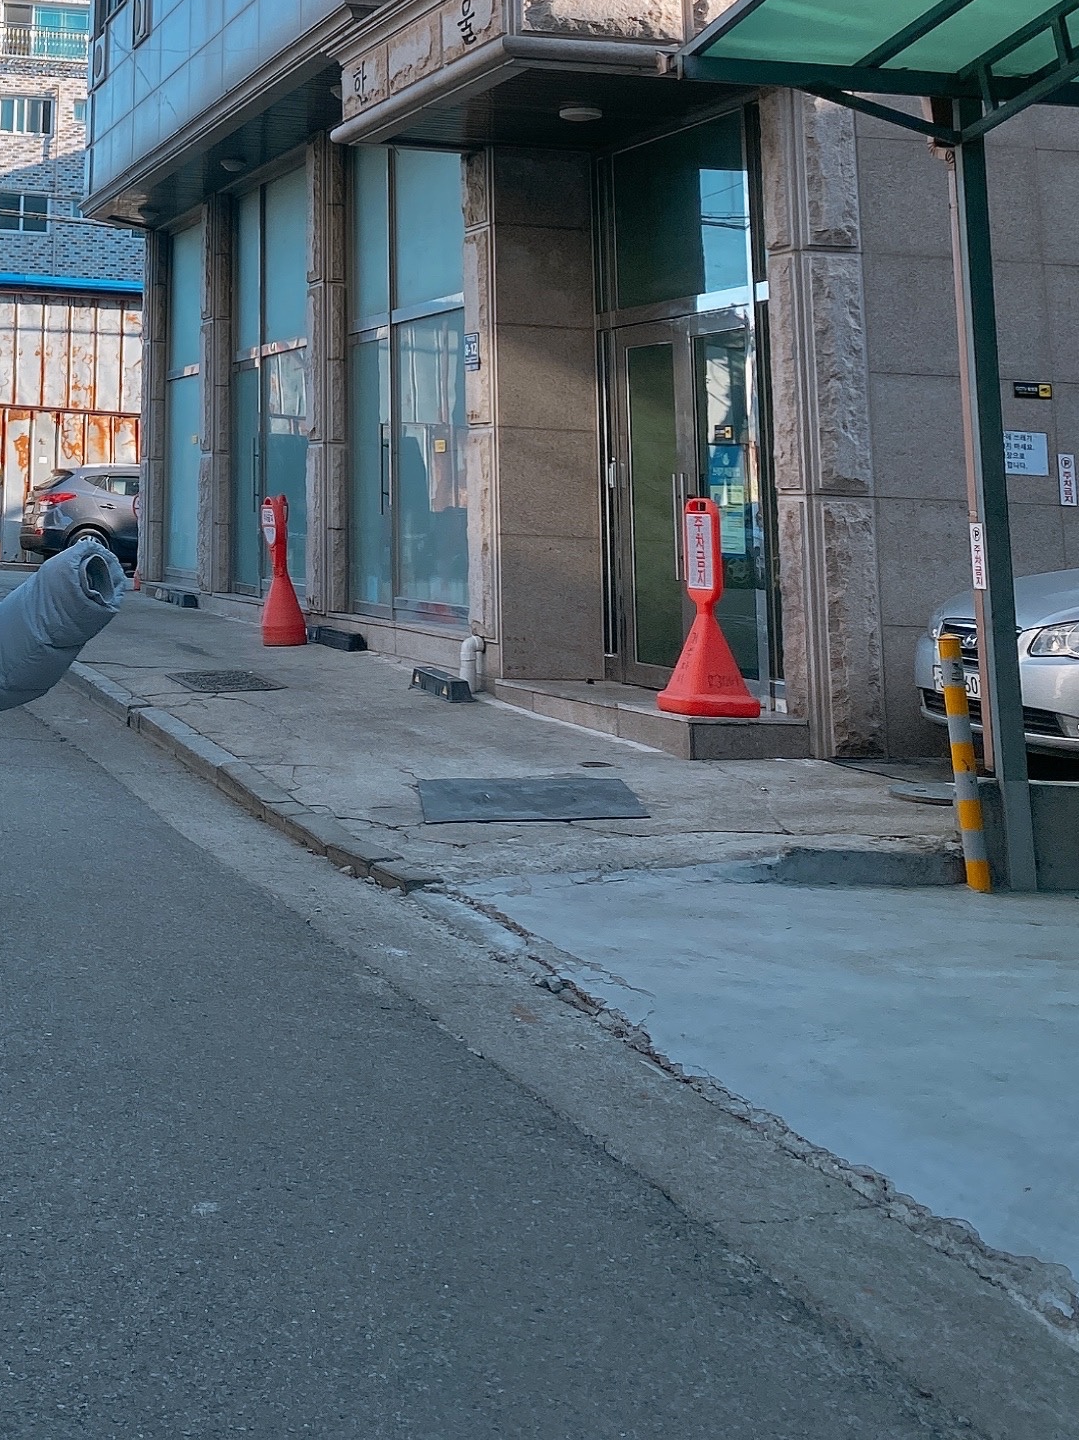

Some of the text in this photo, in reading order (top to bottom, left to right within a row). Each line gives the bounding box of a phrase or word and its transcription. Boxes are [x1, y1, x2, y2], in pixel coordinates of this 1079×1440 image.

[1063, 471, 1074, 503] 주차금지
[694, 516, 706, 586] 주차금지
[974, 544, 983, 585] 주차금지
